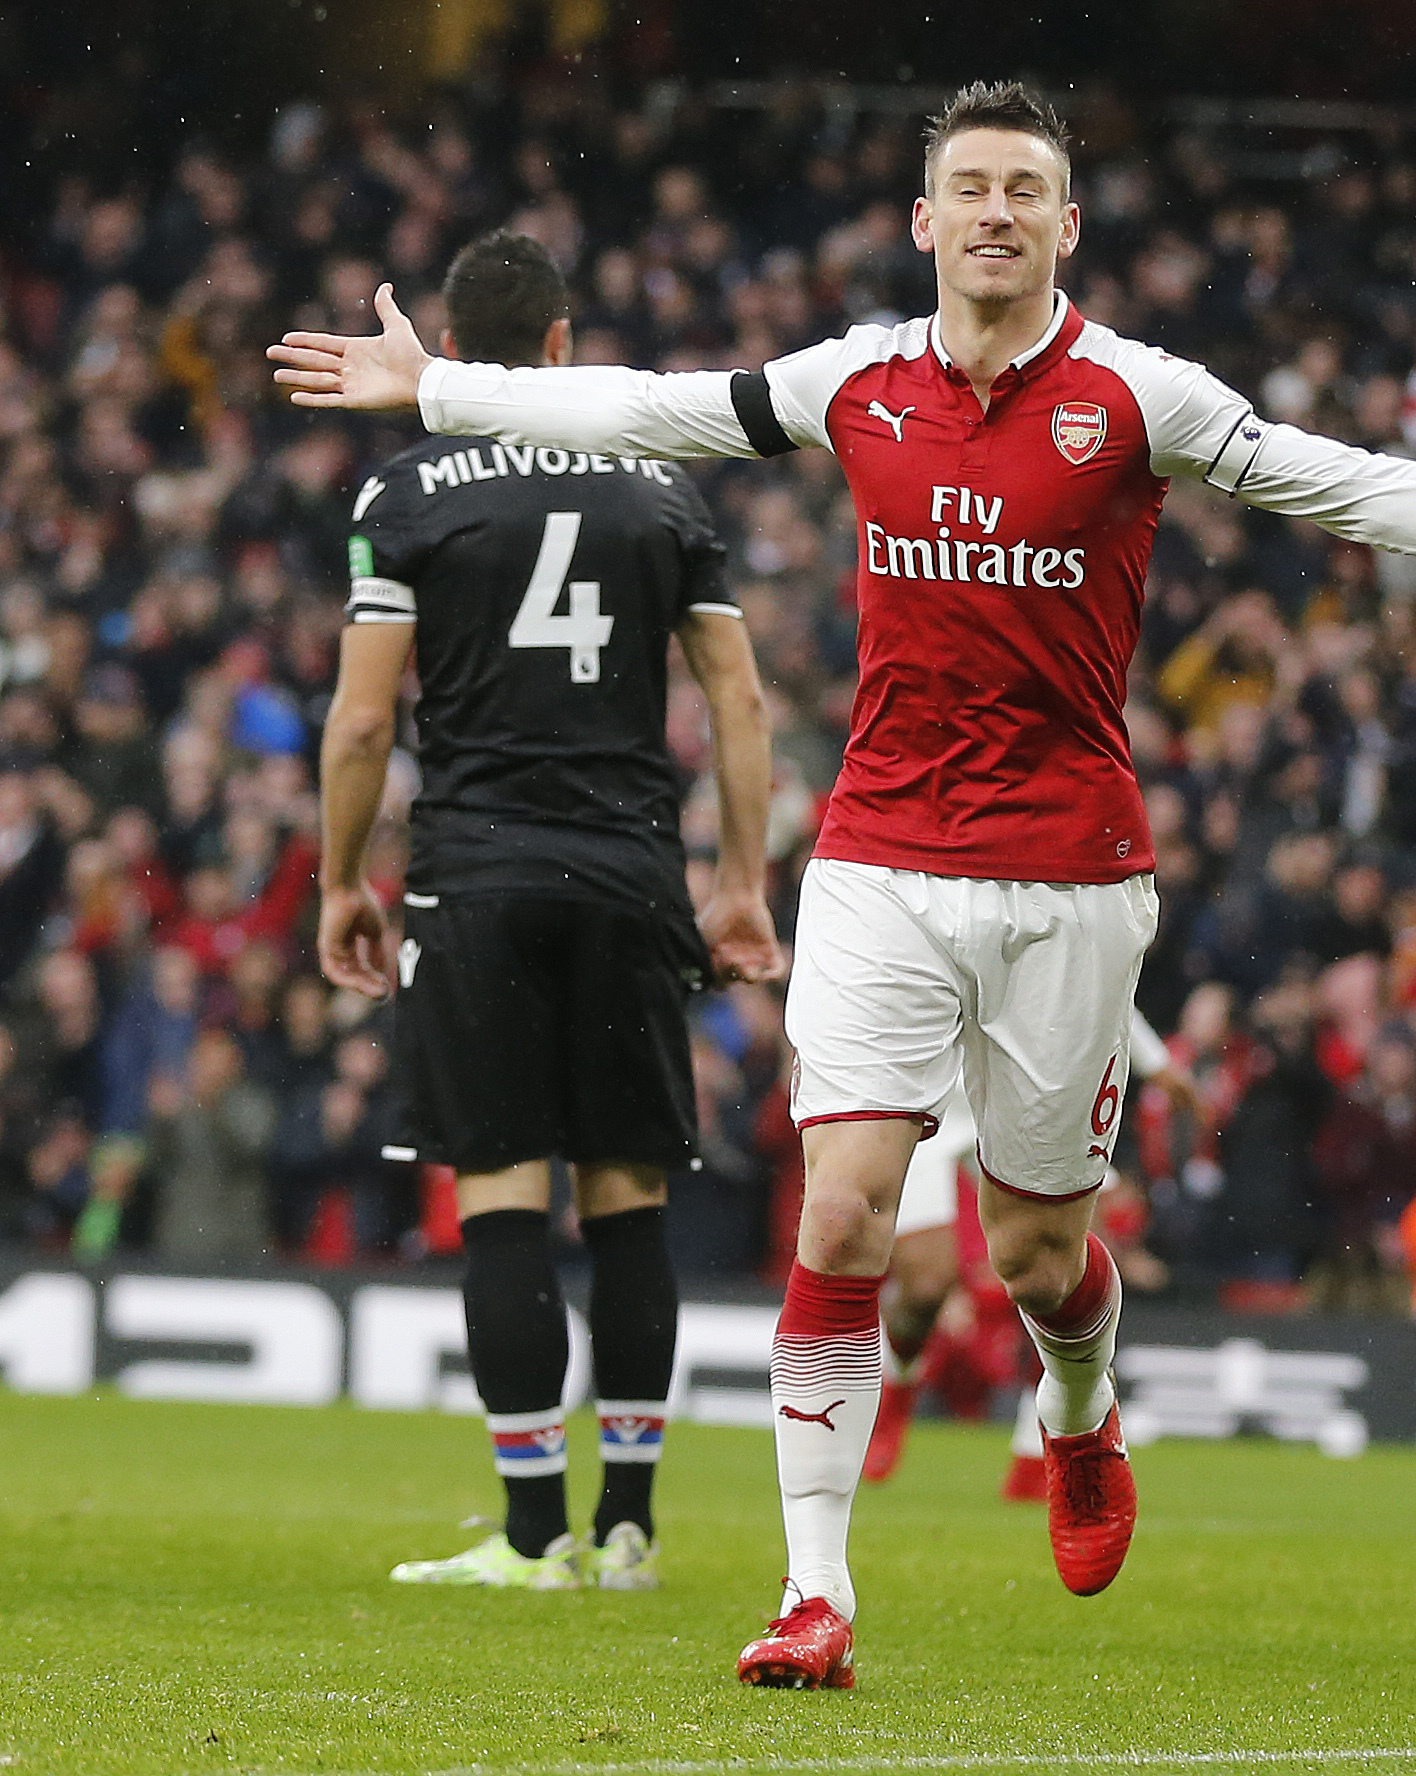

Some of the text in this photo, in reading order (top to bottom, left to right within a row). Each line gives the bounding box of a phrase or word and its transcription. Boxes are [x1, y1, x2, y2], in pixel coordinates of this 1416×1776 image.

[1060, 411, 1099, 424] Arsenal
[931, 485, 1003, 534] Fly
[865, 521, 1086, 588] Emirates
[509, 511, 614, 683] 4
[1091, 1053, 1118, 1136] 6
